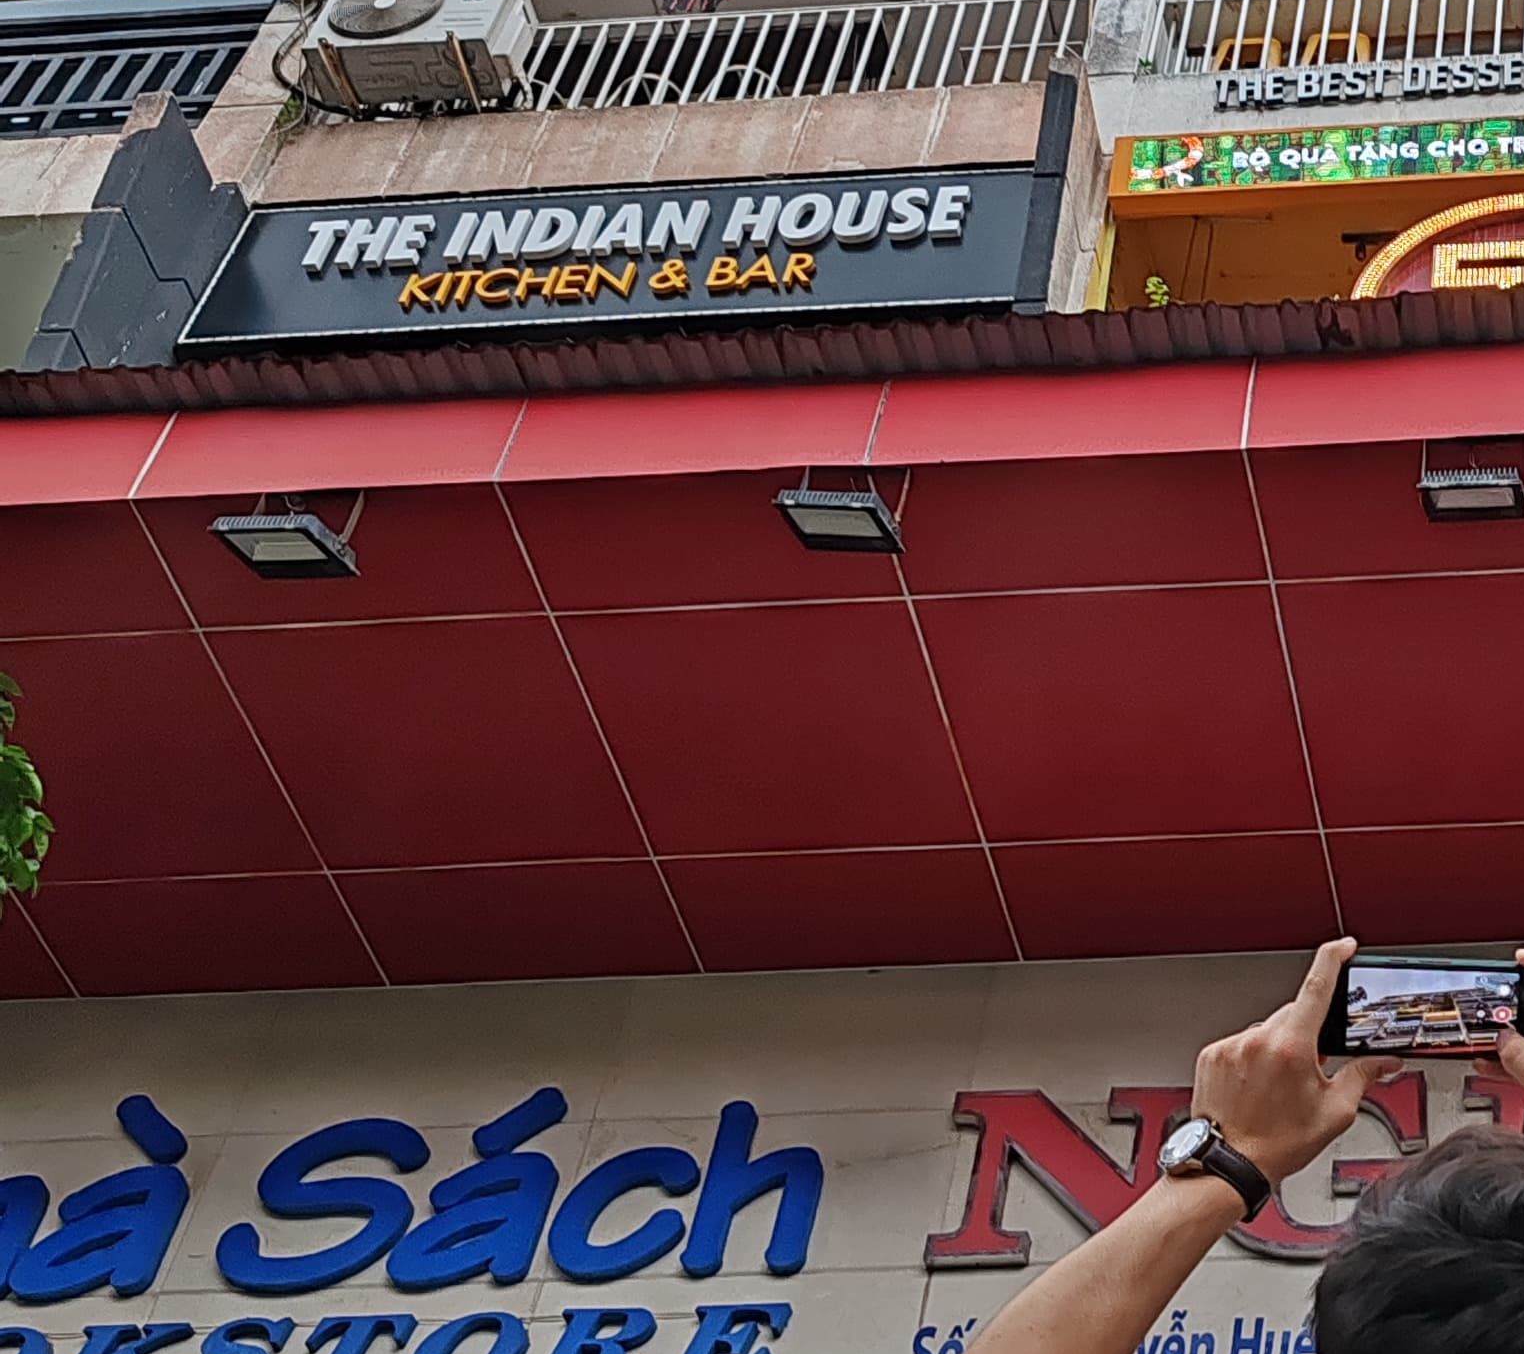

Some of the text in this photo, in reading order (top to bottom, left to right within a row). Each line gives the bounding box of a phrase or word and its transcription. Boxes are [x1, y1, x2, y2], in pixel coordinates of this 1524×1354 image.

[1215, 71, 1287, 108] THE
[1297, 64, 1391, 103] BEST
[1426, 135, 1490, 158] CHO
[300, 184, 972, 272] THE INDIAN HOUSE
[397, 250, 818, 312] KITCHEN & BAR
[215, 1086, 824, 1296] Sách
